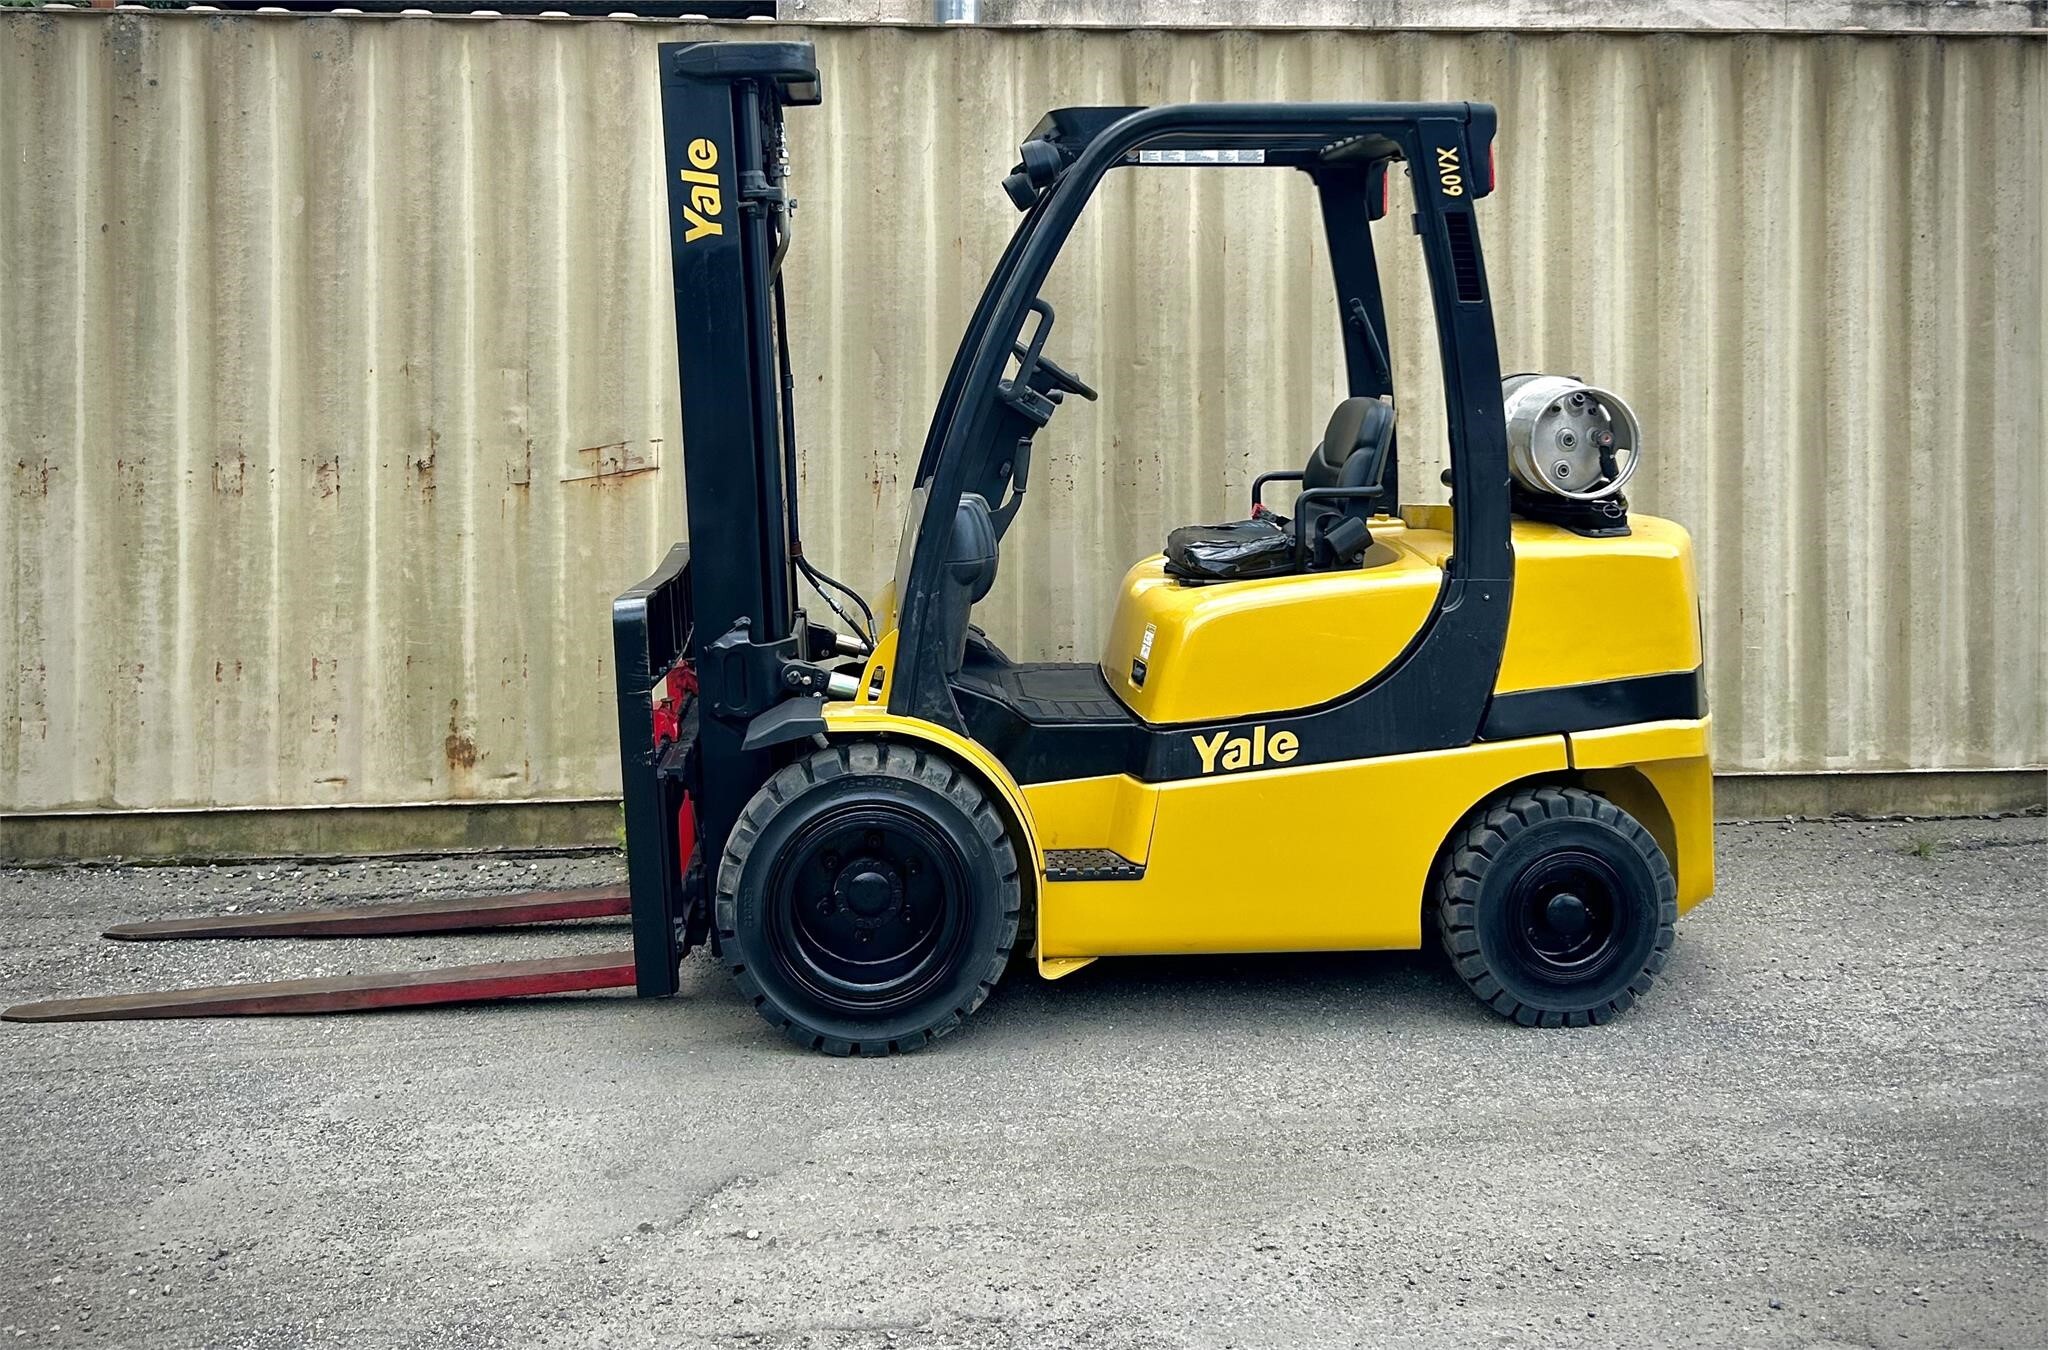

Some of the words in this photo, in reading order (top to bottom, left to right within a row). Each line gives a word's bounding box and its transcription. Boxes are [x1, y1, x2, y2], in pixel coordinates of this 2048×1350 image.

[680, 138, 723, 243] Yale
[1436, 147, 1463, 196] 60VX
[1191, 725, 1299, 774] Yale
